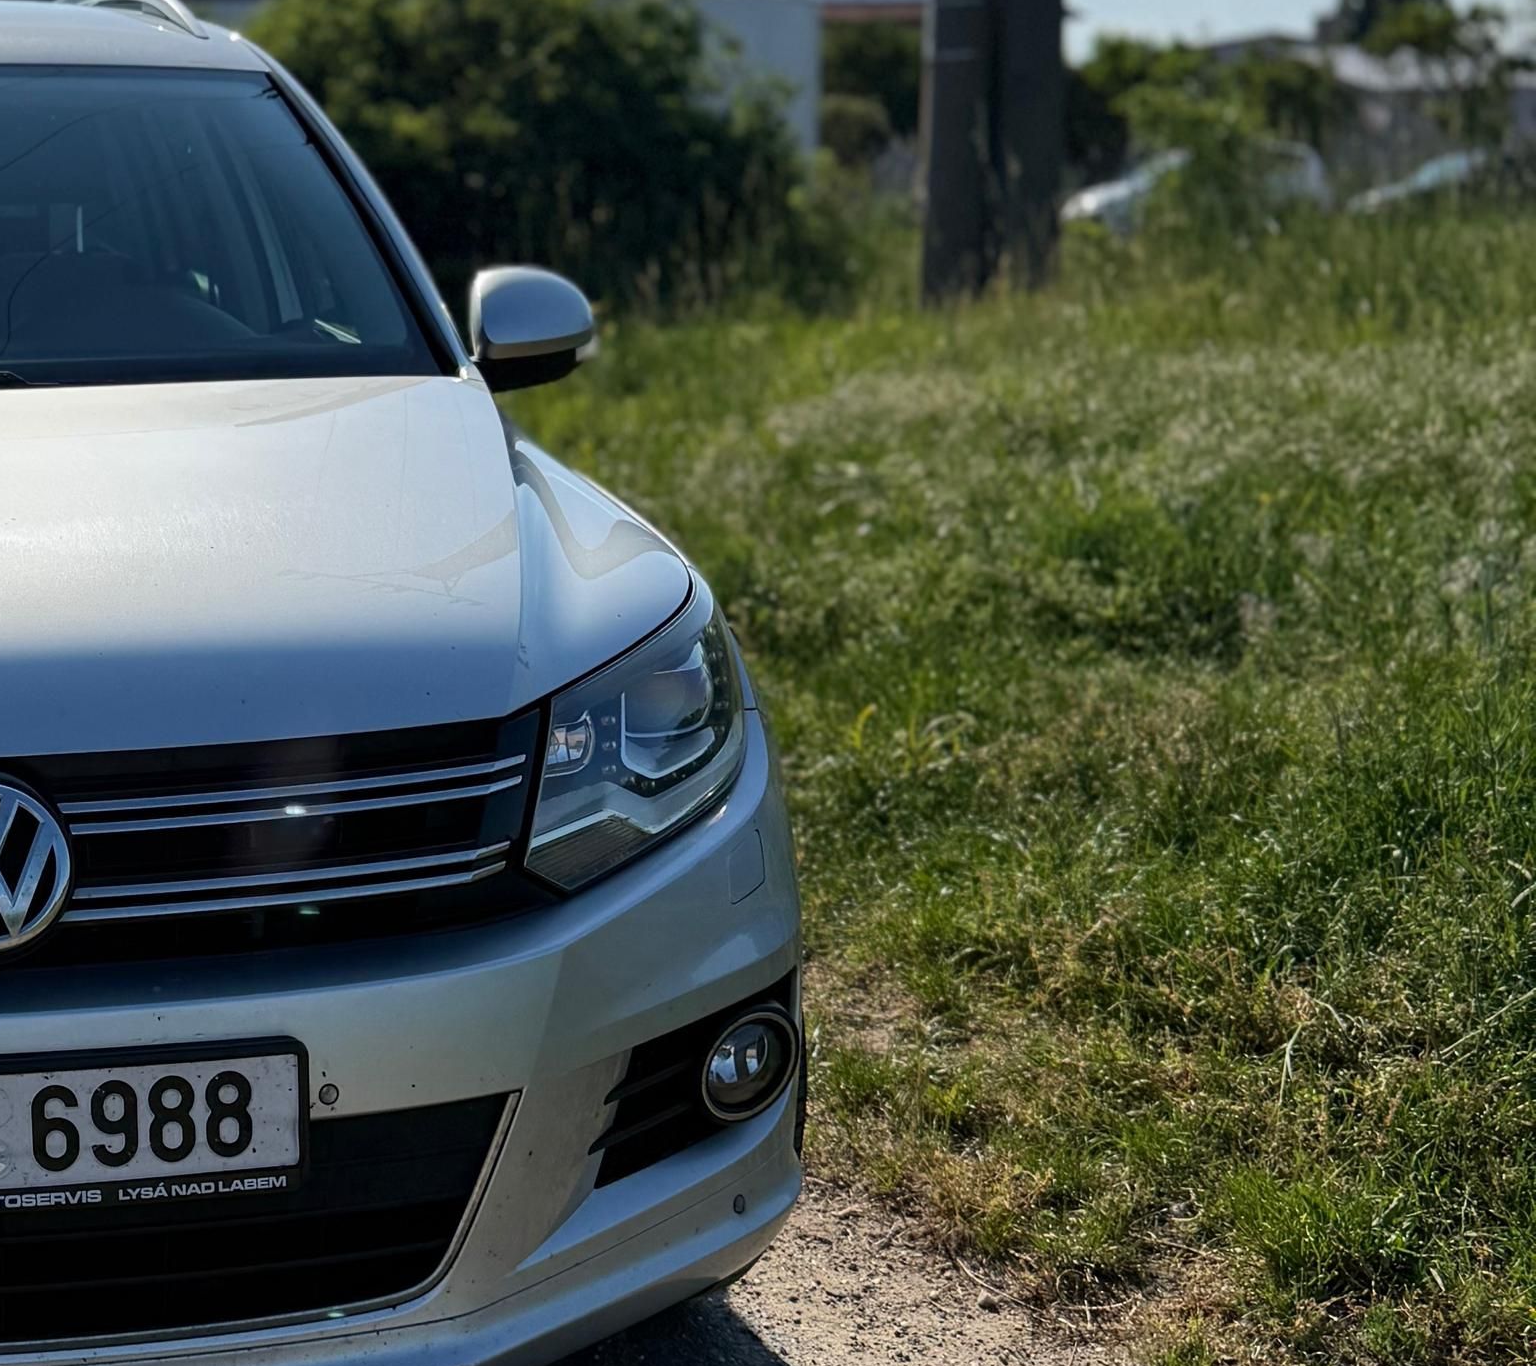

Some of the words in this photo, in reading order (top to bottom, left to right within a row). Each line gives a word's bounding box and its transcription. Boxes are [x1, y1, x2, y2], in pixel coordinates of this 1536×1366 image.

[30, 1070, 253, 1173] 6988
[118, 1181, 168, 1201] LYSÁ
[170, 1181, 216, 1197] NAD
[218, 1175, 287, 1194] LABEM
